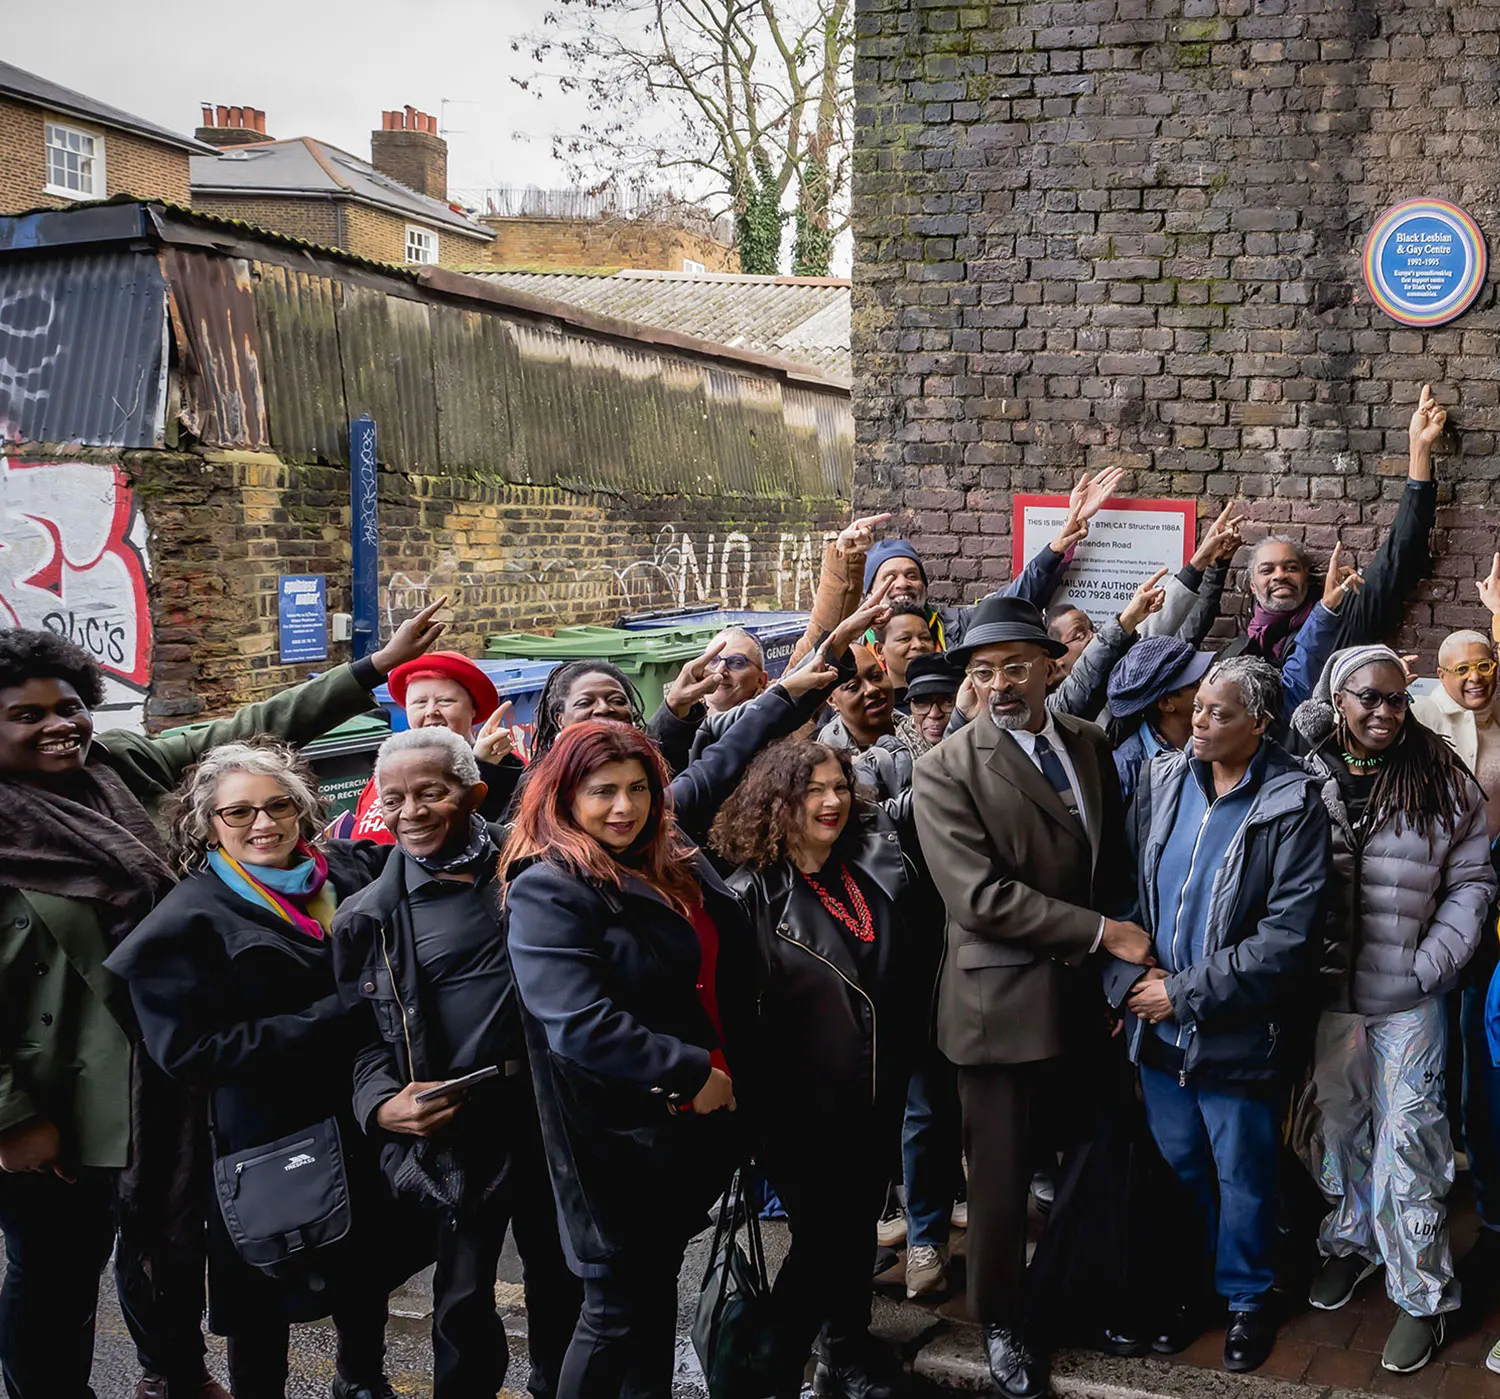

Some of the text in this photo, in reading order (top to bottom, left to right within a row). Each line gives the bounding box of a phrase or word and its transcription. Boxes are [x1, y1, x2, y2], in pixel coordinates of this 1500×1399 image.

[1396, 232, 1452, 243] Black Lesbian
[1396, 244, 1452, 256] & Gay Centre
[1128, 523, 1161, 531] Structure
[1078, 540, 1132, 549] ellenden Road
[1068, 589, 1087, 599] 020
[1088, 590, 1111, 600] 7928
[766, 643, 796, 660] GENERA
